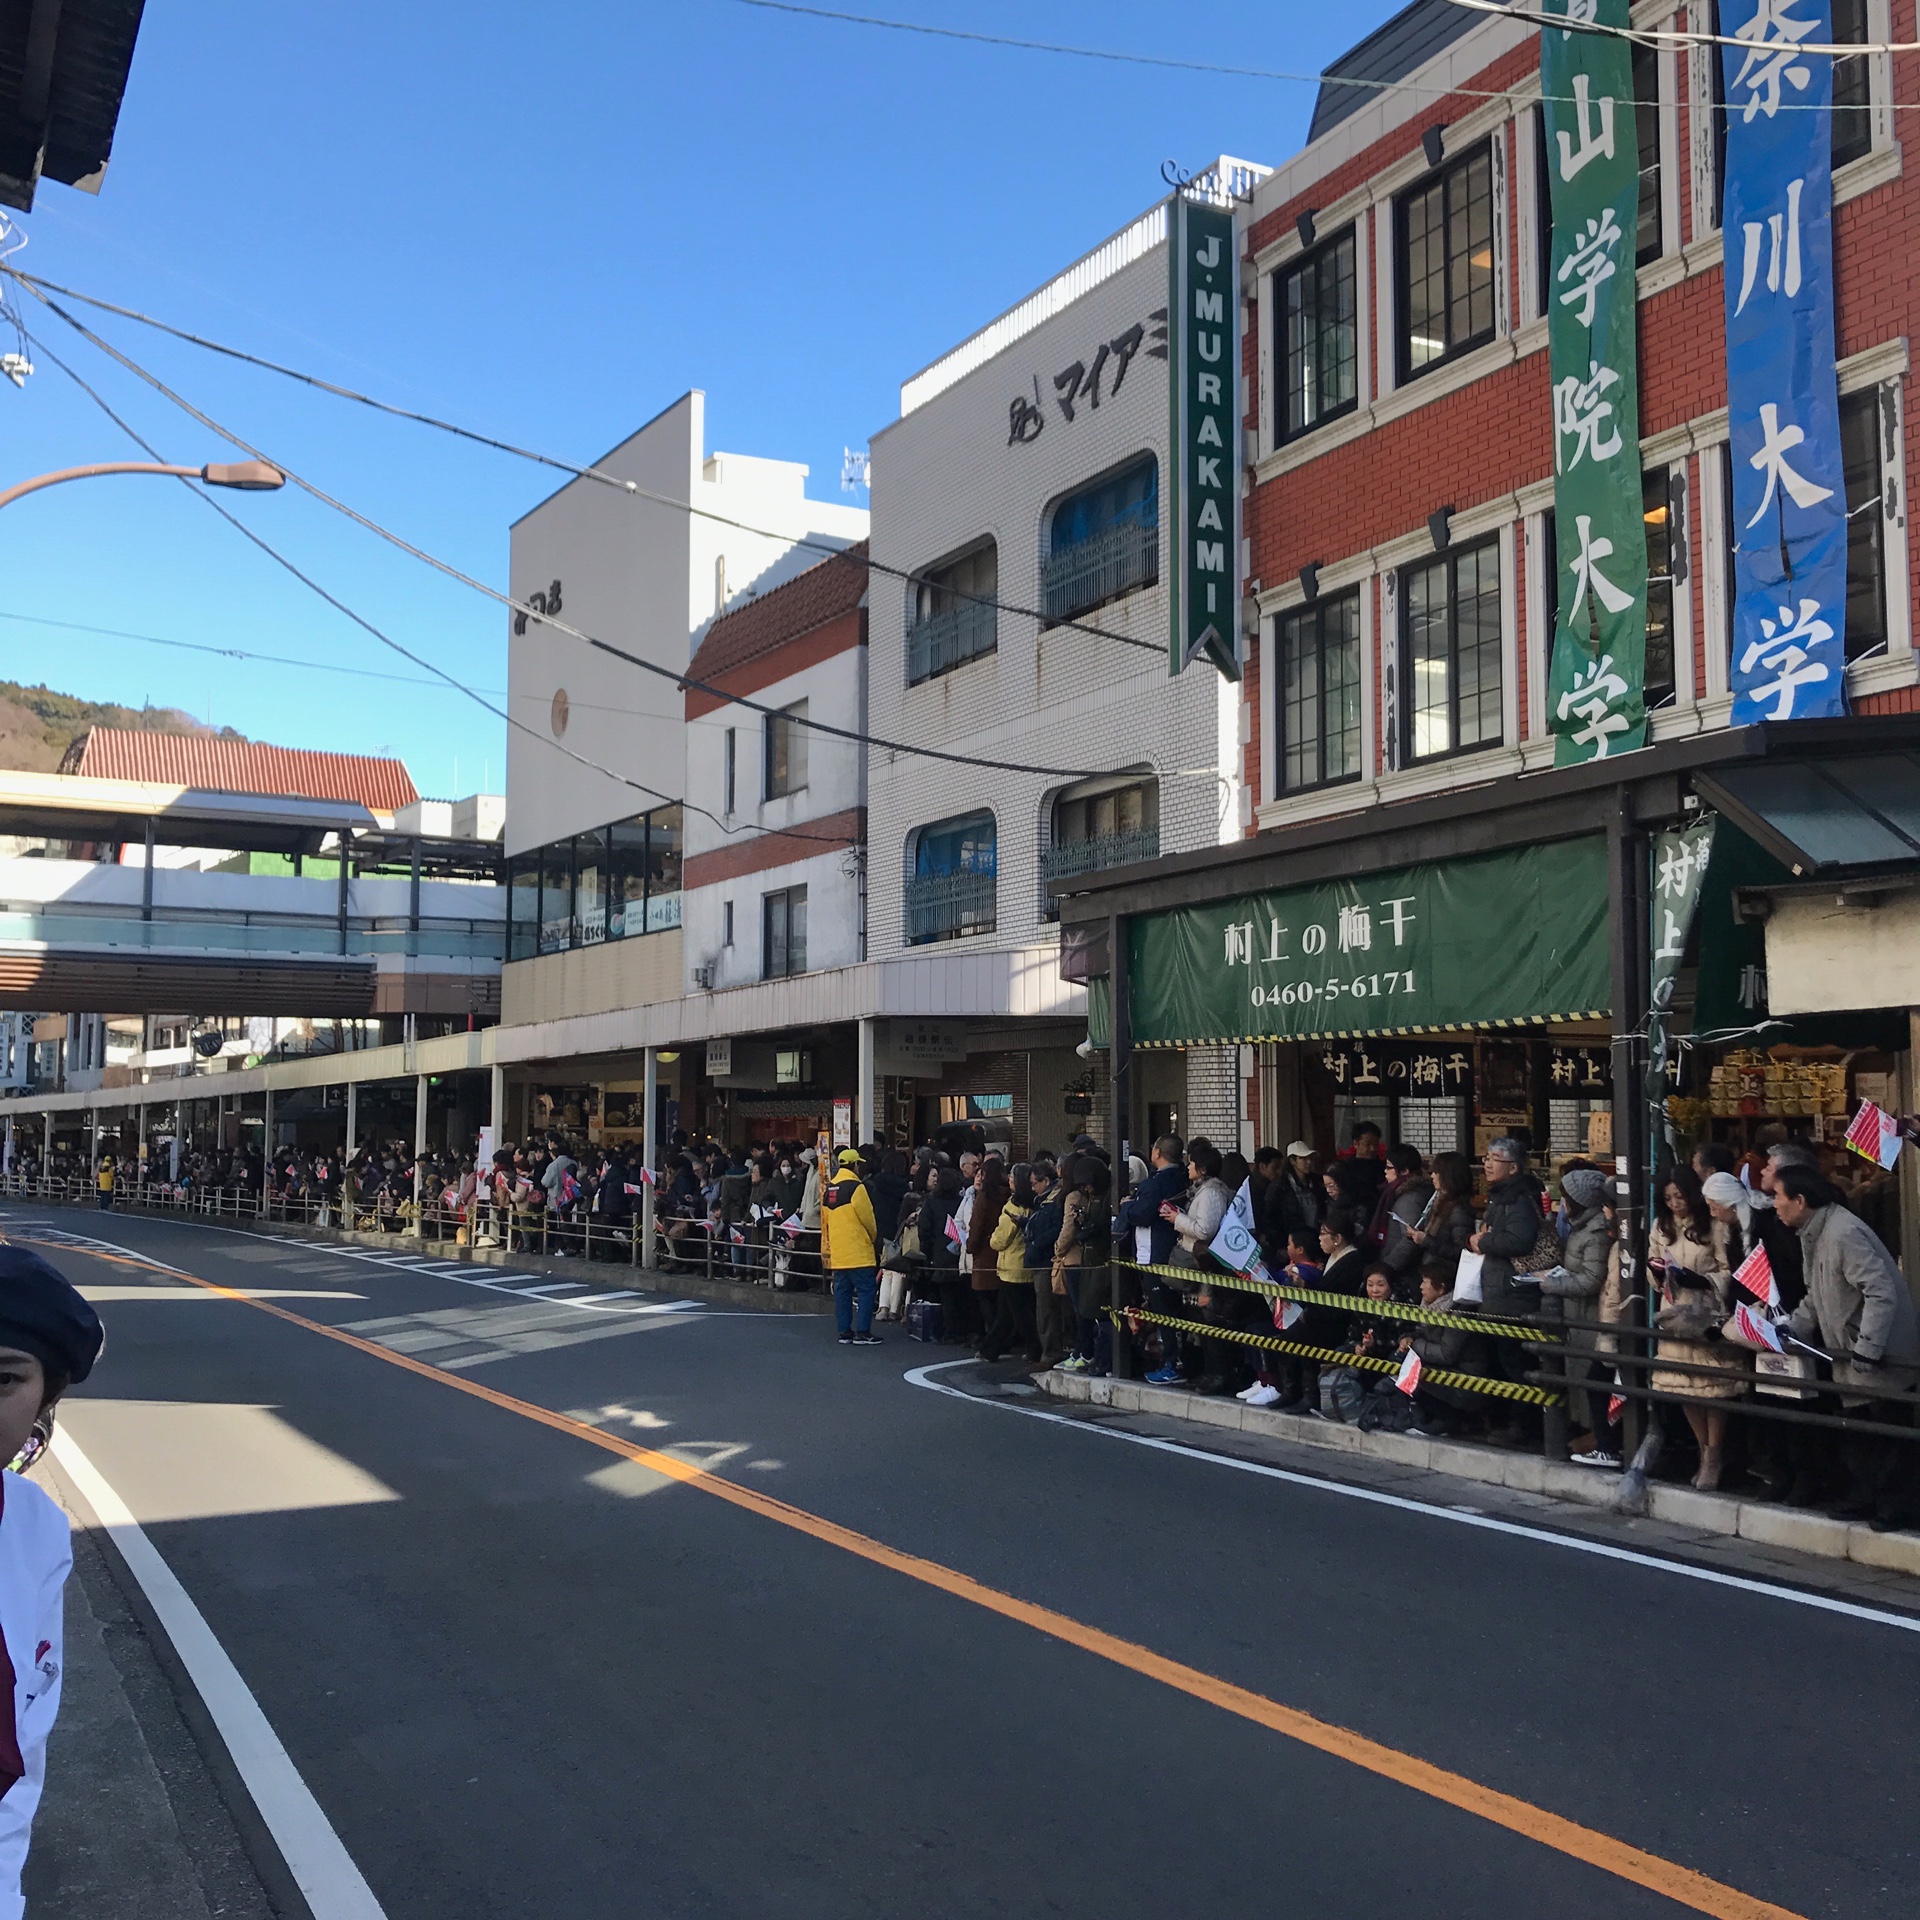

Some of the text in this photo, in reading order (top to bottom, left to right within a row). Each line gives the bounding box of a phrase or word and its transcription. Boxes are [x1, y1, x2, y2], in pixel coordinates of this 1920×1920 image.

[1224, 896, 1416, 966] 村上の梅干
[1251, 969, 1416, 1007] 0460-5-6171
[1323, 1052, 1469, 1086] 村上の梅干
